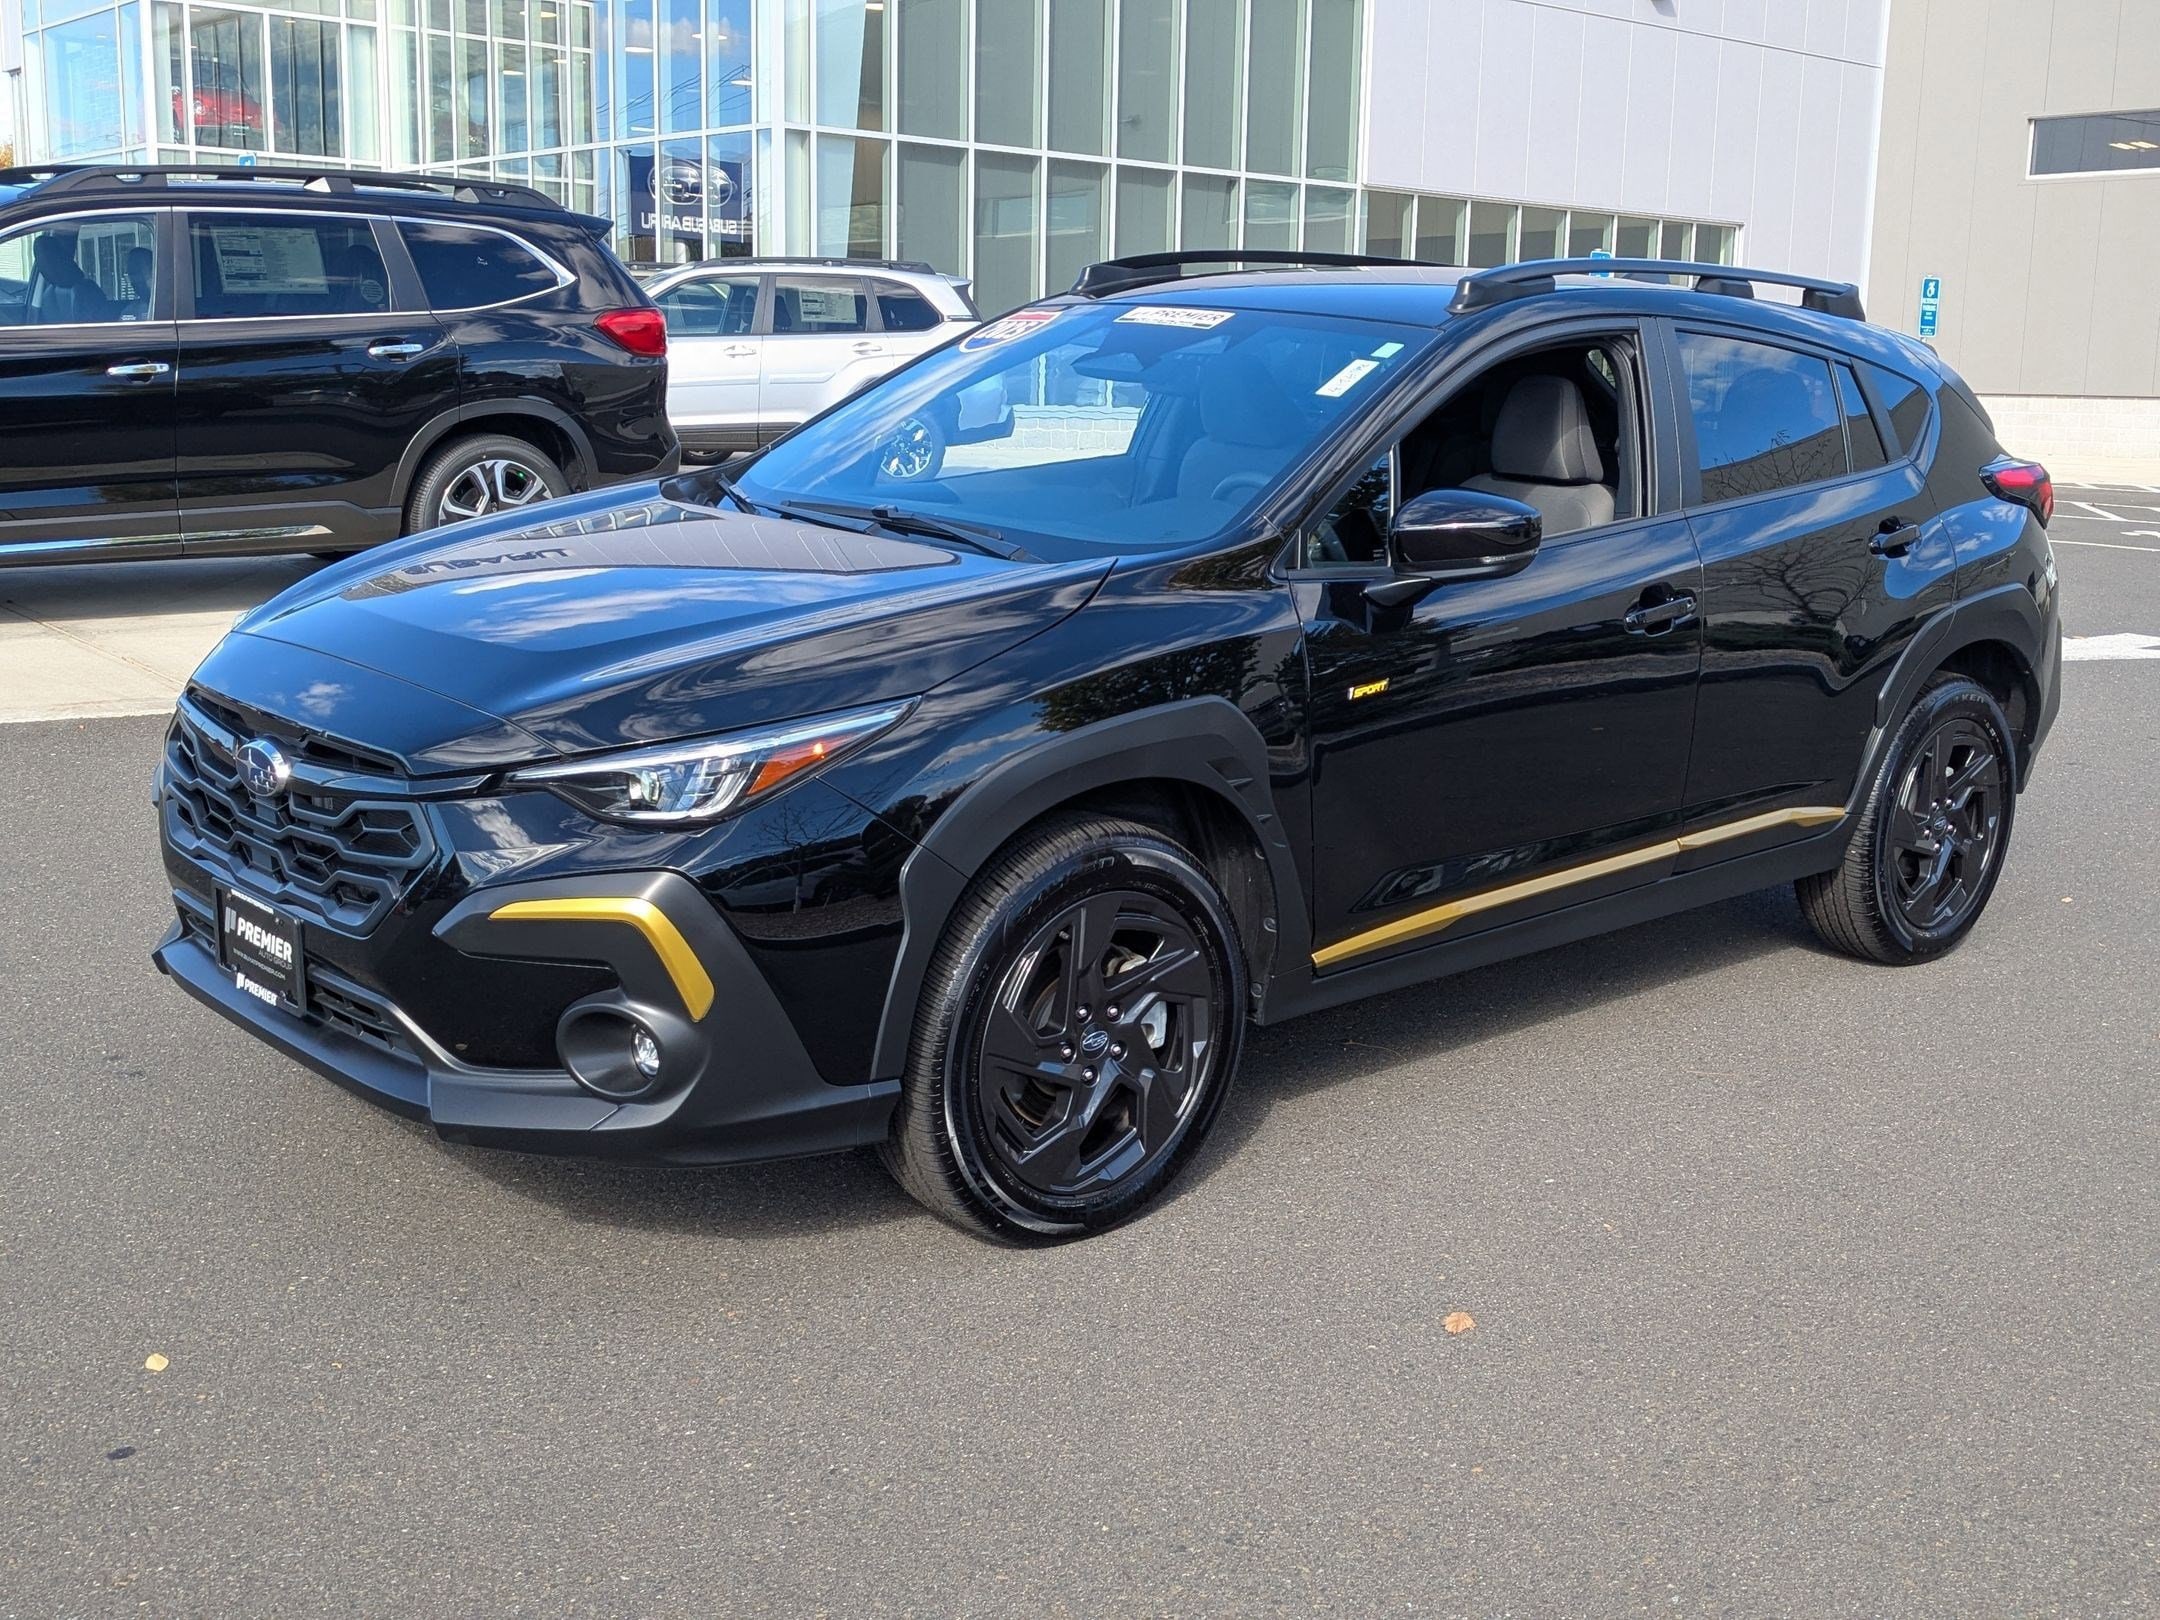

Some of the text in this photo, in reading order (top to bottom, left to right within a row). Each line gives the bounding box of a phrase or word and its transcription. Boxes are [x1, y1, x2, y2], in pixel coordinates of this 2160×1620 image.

[1153, 309, 1226, 322] PREMIER
[1353, 680, 1388, 698] SPORT
[237, 917, 293, 963] PREMIER
[258, 950, 272, 962] AUTO
[244, 978, 278, 1006] PREMIER
